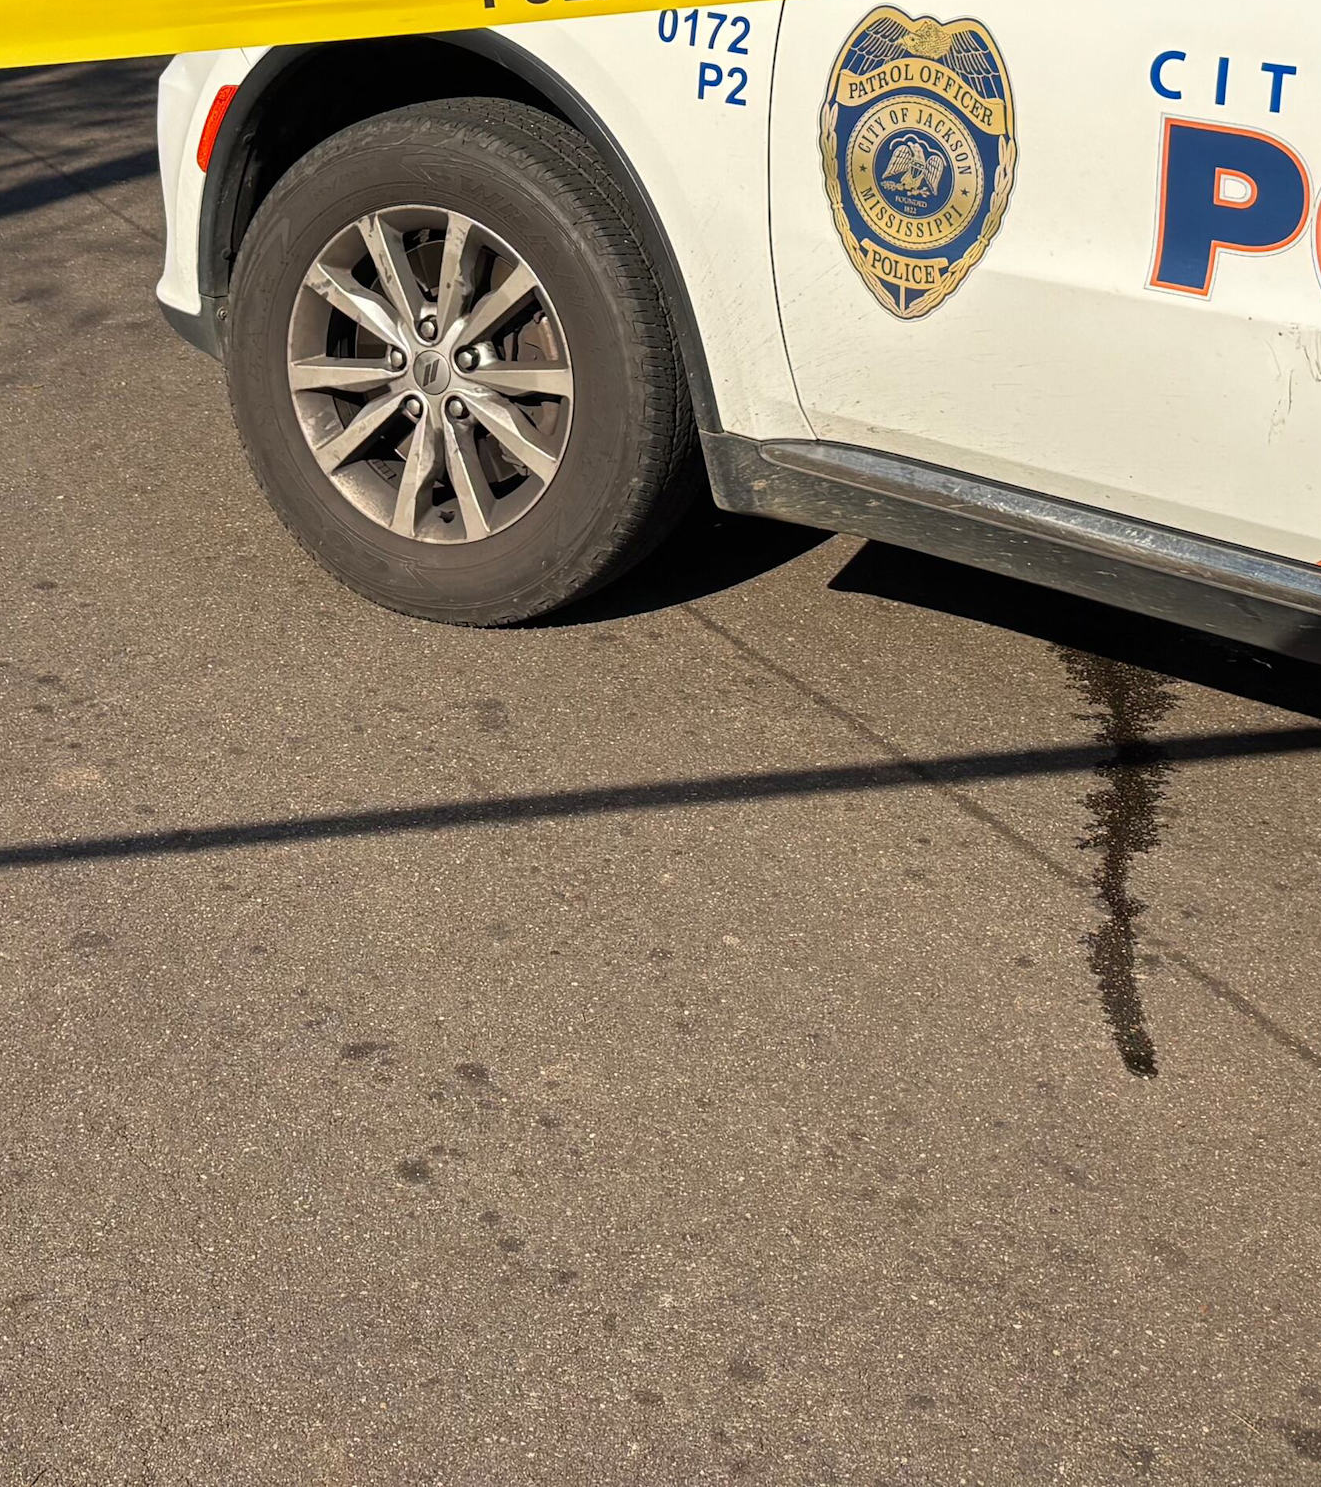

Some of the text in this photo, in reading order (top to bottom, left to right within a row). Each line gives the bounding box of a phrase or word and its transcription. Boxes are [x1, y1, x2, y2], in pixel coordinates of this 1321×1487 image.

[657, 8, 751, 55] 0172
[697, 62, 749, 106] P2
[848, 63, 995, 127] PATROL OFFICER
[858, 107, 973, 178] CITY OF JACKSON
[859, 186, 965, 239] MISSISSIPPI
[869, 248, 936, 285] POLICE
